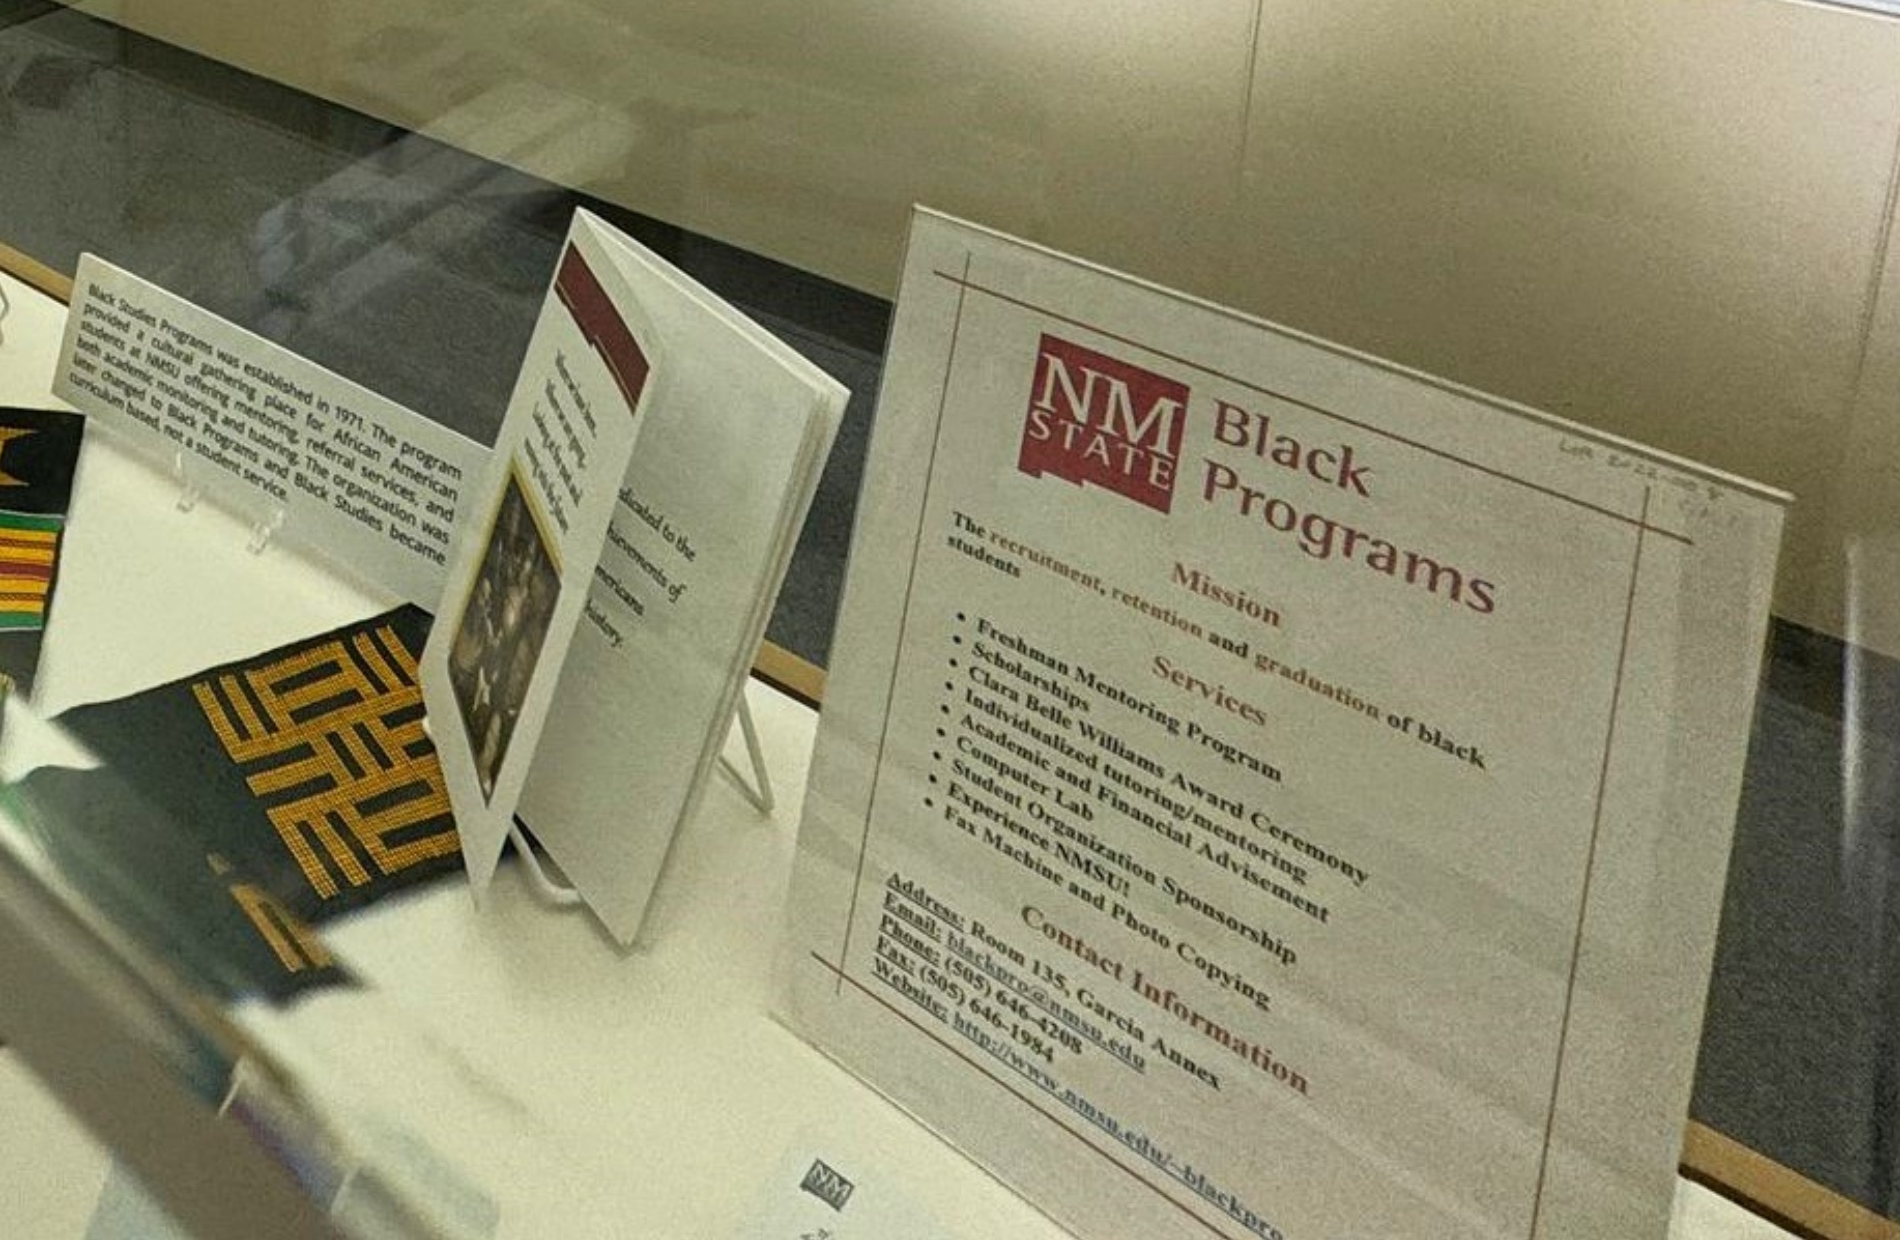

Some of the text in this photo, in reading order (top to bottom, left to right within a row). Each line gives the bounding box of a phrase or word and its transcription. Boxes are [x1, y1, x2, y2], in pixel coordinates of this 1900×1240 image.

[144, 351, 181, 380] NMSU
[183, 374, 231, 409] offering
[306, 437, 357, 472] referral
[360, 465, 420, 507] services,
[425, 500, 455, 524] and
[159, 318, 214, 356] Programs
[216, 348, 240, 369] was
[243, 362, 314, 406] established
[316, 395, 330, 414] in
[335, 405, 366, 434] 1971.
[371, 422, 398, 449] The
[399, 441, 463, 481] program
[163, 424, 184, 443] not
[185, 436, 194, 449] a
[194, 442, 242, 475] student
[263, 394, 298, 420] place
[305, 412, 326, 434] for
[332, 428, 382, 463] African
[389, 456, 459, 504] American
[1028, 409, 1174, 493] STATE
[1036, 353, 1183, 461] NM
[1212, 397, 1372, 500] Black
[150, 395, 163, 411] to
[167, 403, 197, 429] Black
[202, 422, 260, 464] Programs
[263, 458, 289, 480] and
[293, 471, 330, 502] Black
[334, 494, 384, 532] Studies
[389, 522, 447, 567] became
[220, 414, 246, 435] and
[305, 454, 330, 480] The
[332, 473, 417, 528] organization
[421, 519, 450, 545] was
[662, 524, 675, 543] to
[676, 536, 695, 561] the
[1200, 456, 1496, 616] Programs
[607, 520, 687, 603] hievements of
[947, 535, 1021, 580] students
[1172, 560, 1282, 630] Mission
[953, 511, 1487, 771] The recruitment, retention and graduation of black
[971, 642, 1091, 713] Scholarships
[976, 616, 1282, 783] Freshman Mentoring Program
[1151, 654, 1269, 729] Services
[946, 782, 1131, 898] Experience NMSU!
[956, 736, 1095, 822] Computer Lab
[960, 713, 1330, 924] Academic and Financial Advisement
[964, 687, 1308, 886] Individualized tutoring/mentoring
[968, 665, 1370, 886] Clara Belle Williams Award Ceremony
[943, 807, 1272, 1012] Fax Machine and Photo Copying
[951, 759, 1298, 966] Student Organization Sponsorship
[871, 956, 951, 1027] Website:
[875, 935, 1055, 1063] Fax: (505) 646-1984
[879, 912, 1083, 1055] Phone: (505) 646-4208
[881, 891, 1148, 1075] Email: blackpro@nmsu.edu
[884, 870, 1222, 1093] Address: Room 135, Garcia Annex
[1021, 904, 1309, 1096] Contact Information
